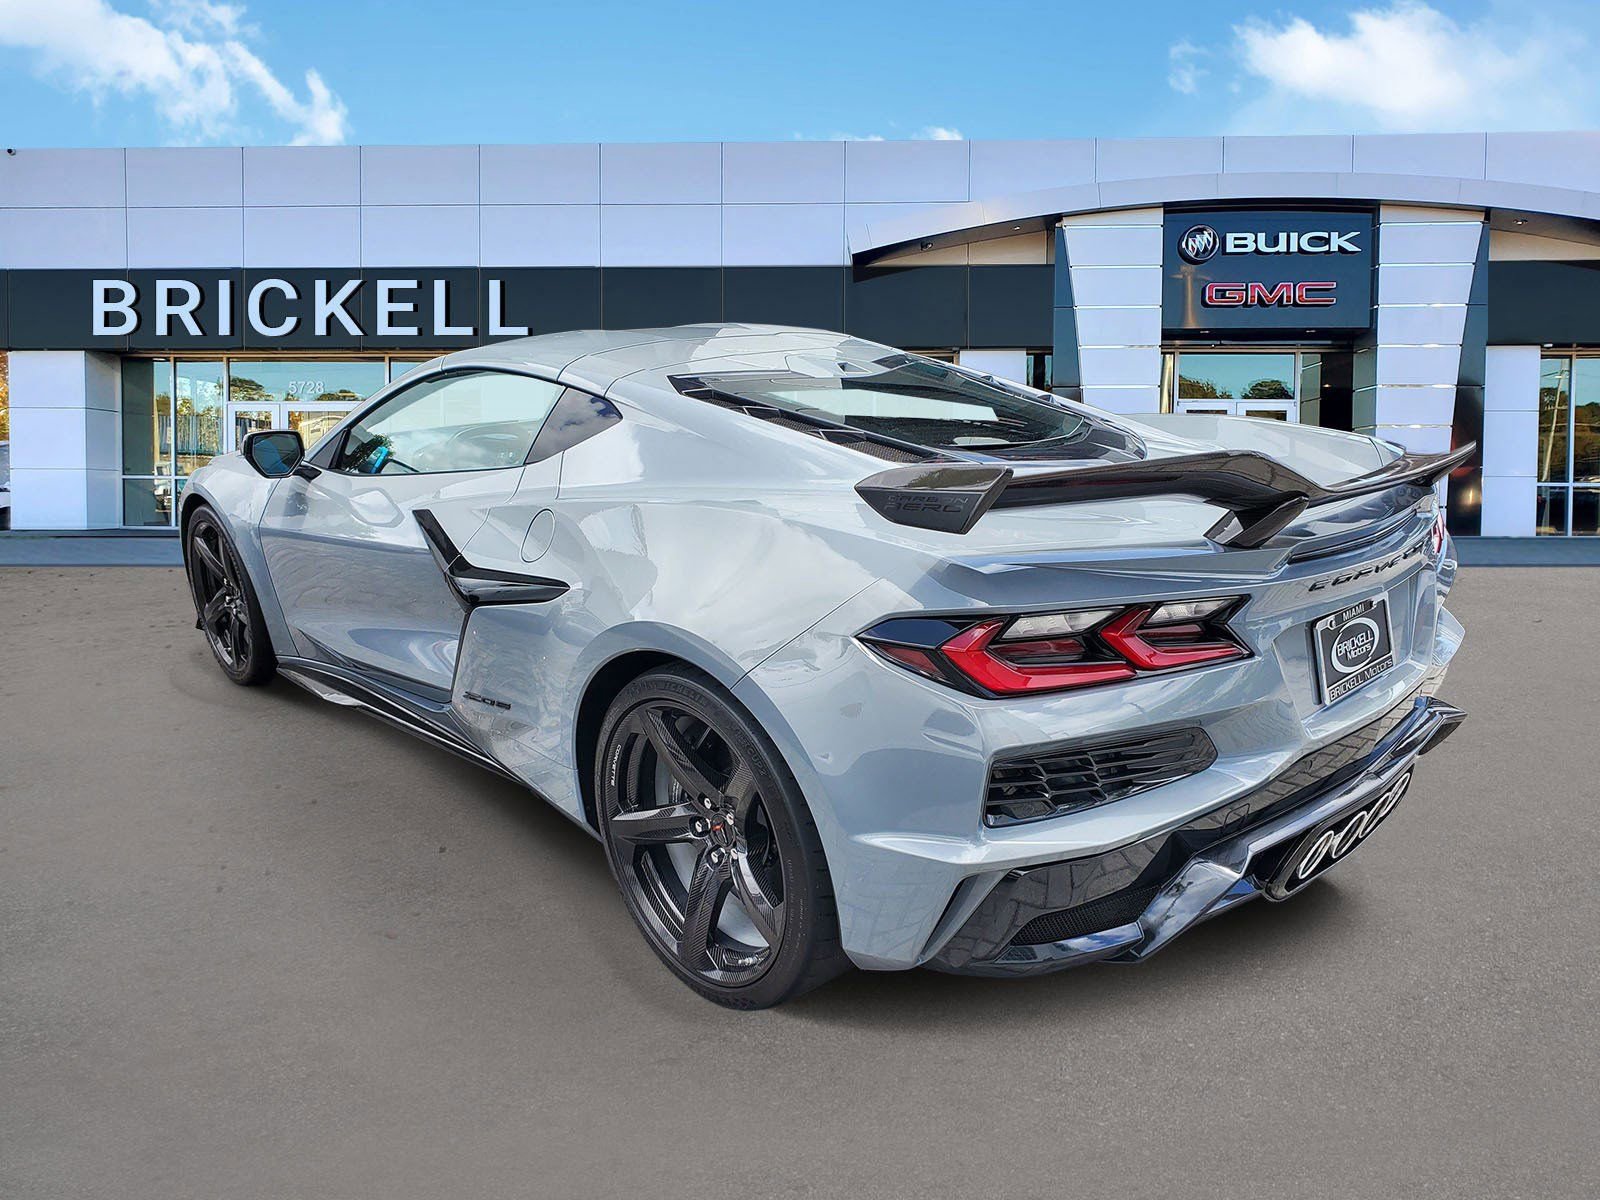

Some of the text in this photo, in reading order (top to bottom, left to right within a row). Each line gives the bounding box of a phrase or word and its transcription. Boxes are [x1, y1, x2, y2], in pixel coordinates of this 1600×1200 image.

[1225, 231, 1361, 253] BUICK
[1205, 281, 1337, 305] GMC
[92, 278, 529, 337] BRICKELL
[288, 380, 324, 394] 5728
[884, 503, 964, 512] AERO
[1342, 604, 1365, 622] MIAMI
[1337, 630, 1374, 657] BRICKELL
[1346, 644, 1372, 661] Motors
[1329, 658, 1393, 701] BRICKELL Motors
[610, 744, 621, 787] CORVETTE
